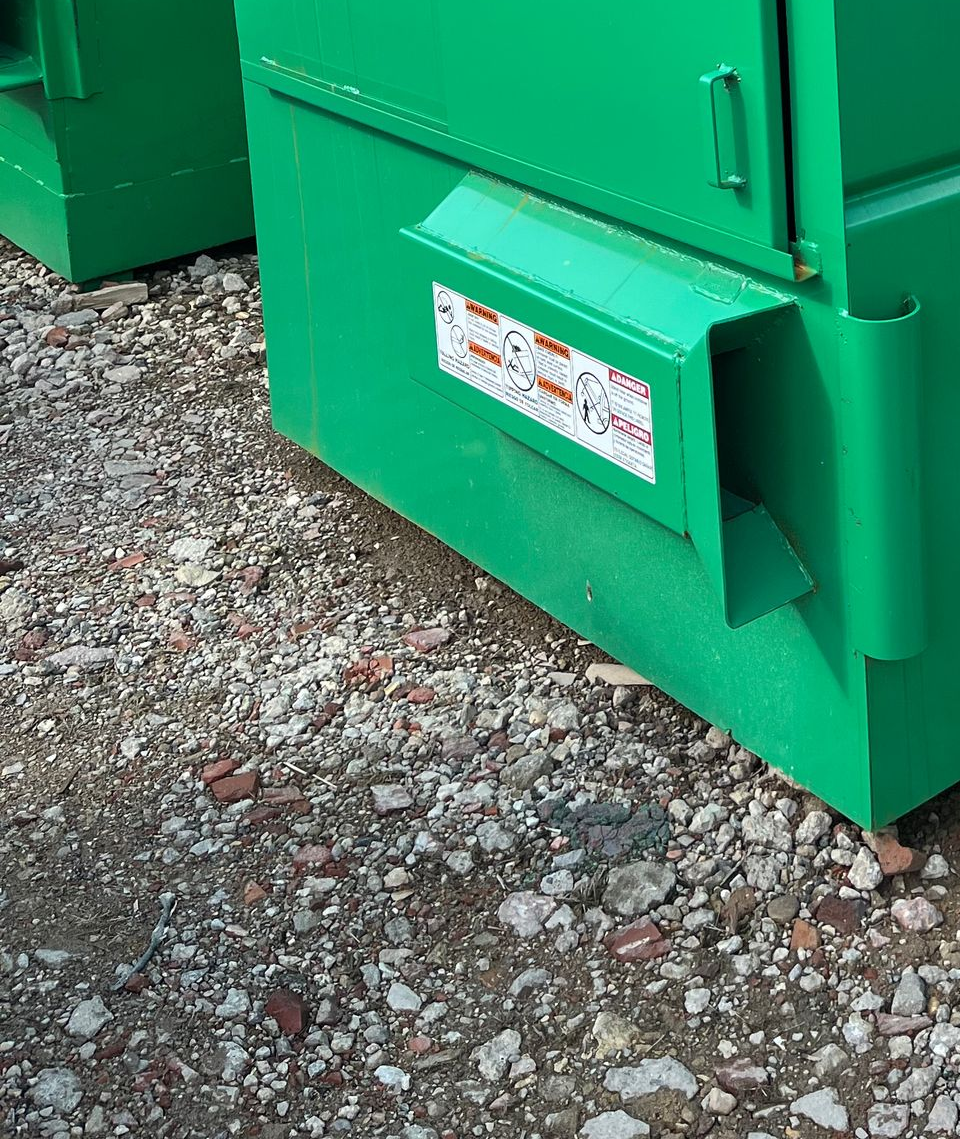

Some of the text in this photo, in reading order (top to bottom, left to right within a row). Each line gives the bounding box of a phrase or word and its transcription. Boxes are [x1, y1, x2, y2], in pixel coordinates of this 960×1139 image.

[470, 304, 498, 322] WARNING
[540, 338, 569, 358] WARNING
[616, 374, 646, 396] DANGER
[618, 418, 650, 440] PELIGRO
